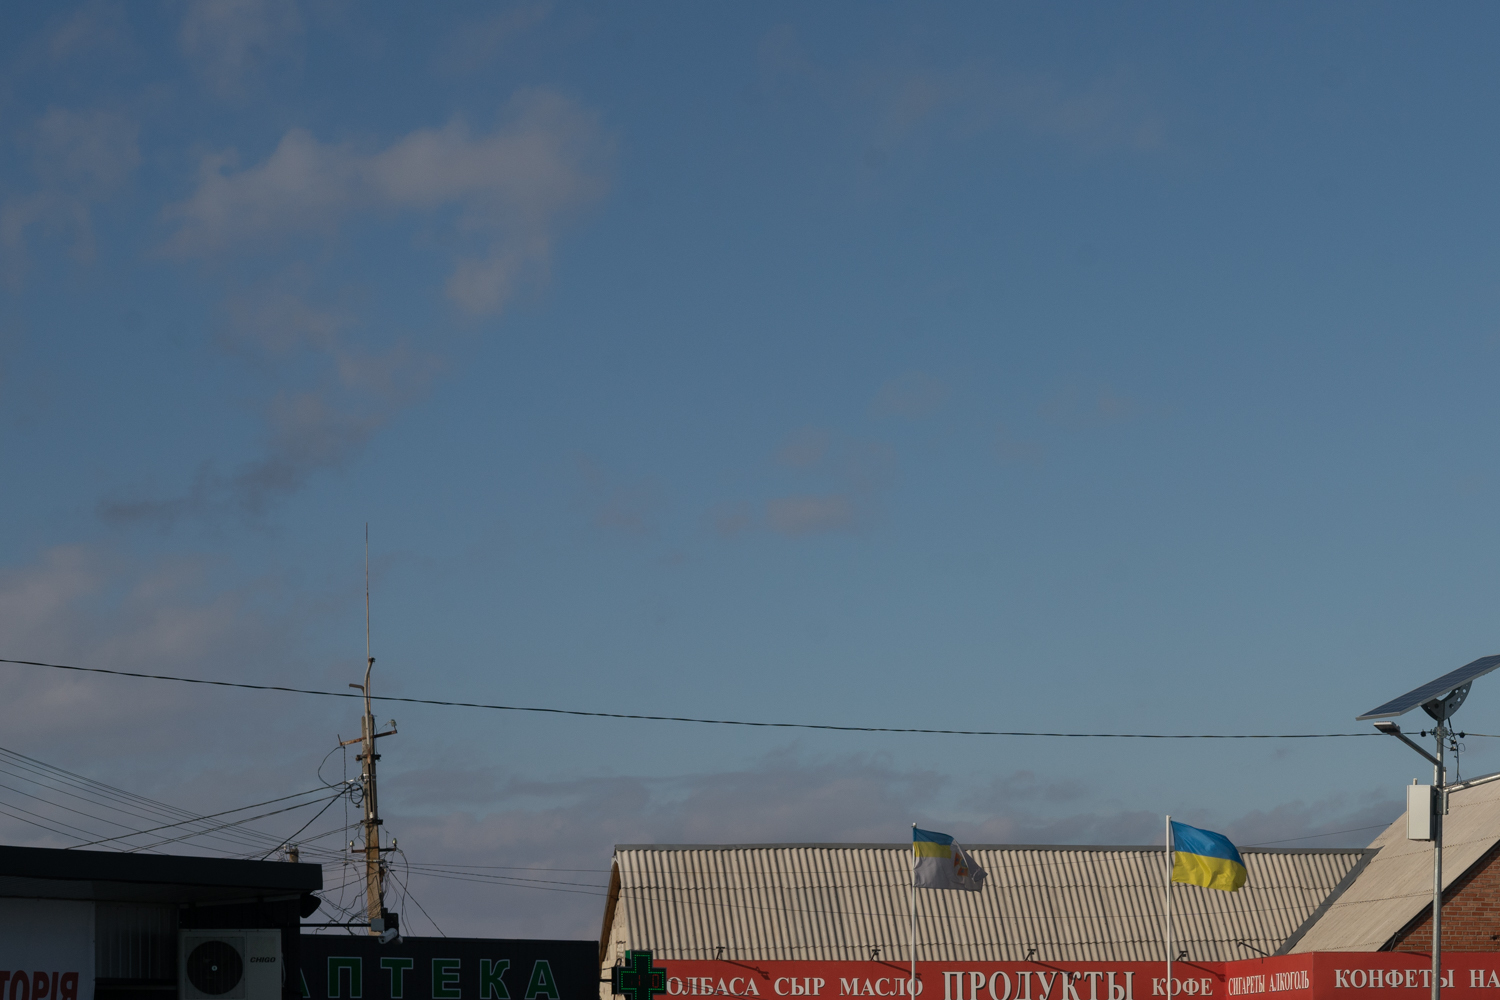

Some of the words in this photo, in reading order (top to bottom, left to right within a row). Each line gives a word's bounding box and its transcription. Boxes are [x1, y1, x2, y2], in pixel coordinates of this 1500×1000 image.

[300, 956, 560, 1000] ПТЕКА
[666, 976, 760, 997] ОЛБАСА
[774, 977, 825, 997] СЫР
[839, 976, 924, 997] МАСЛО
[1152, 976, 1214, 997] КОФЕ
[1228, 972, 1266, 997] СИГАРЕТЫ
[1268, 968, 1310, 994] АЛКОГОЛЬ
[1334, 968, 1455, 989] КОНФЕТЫ
